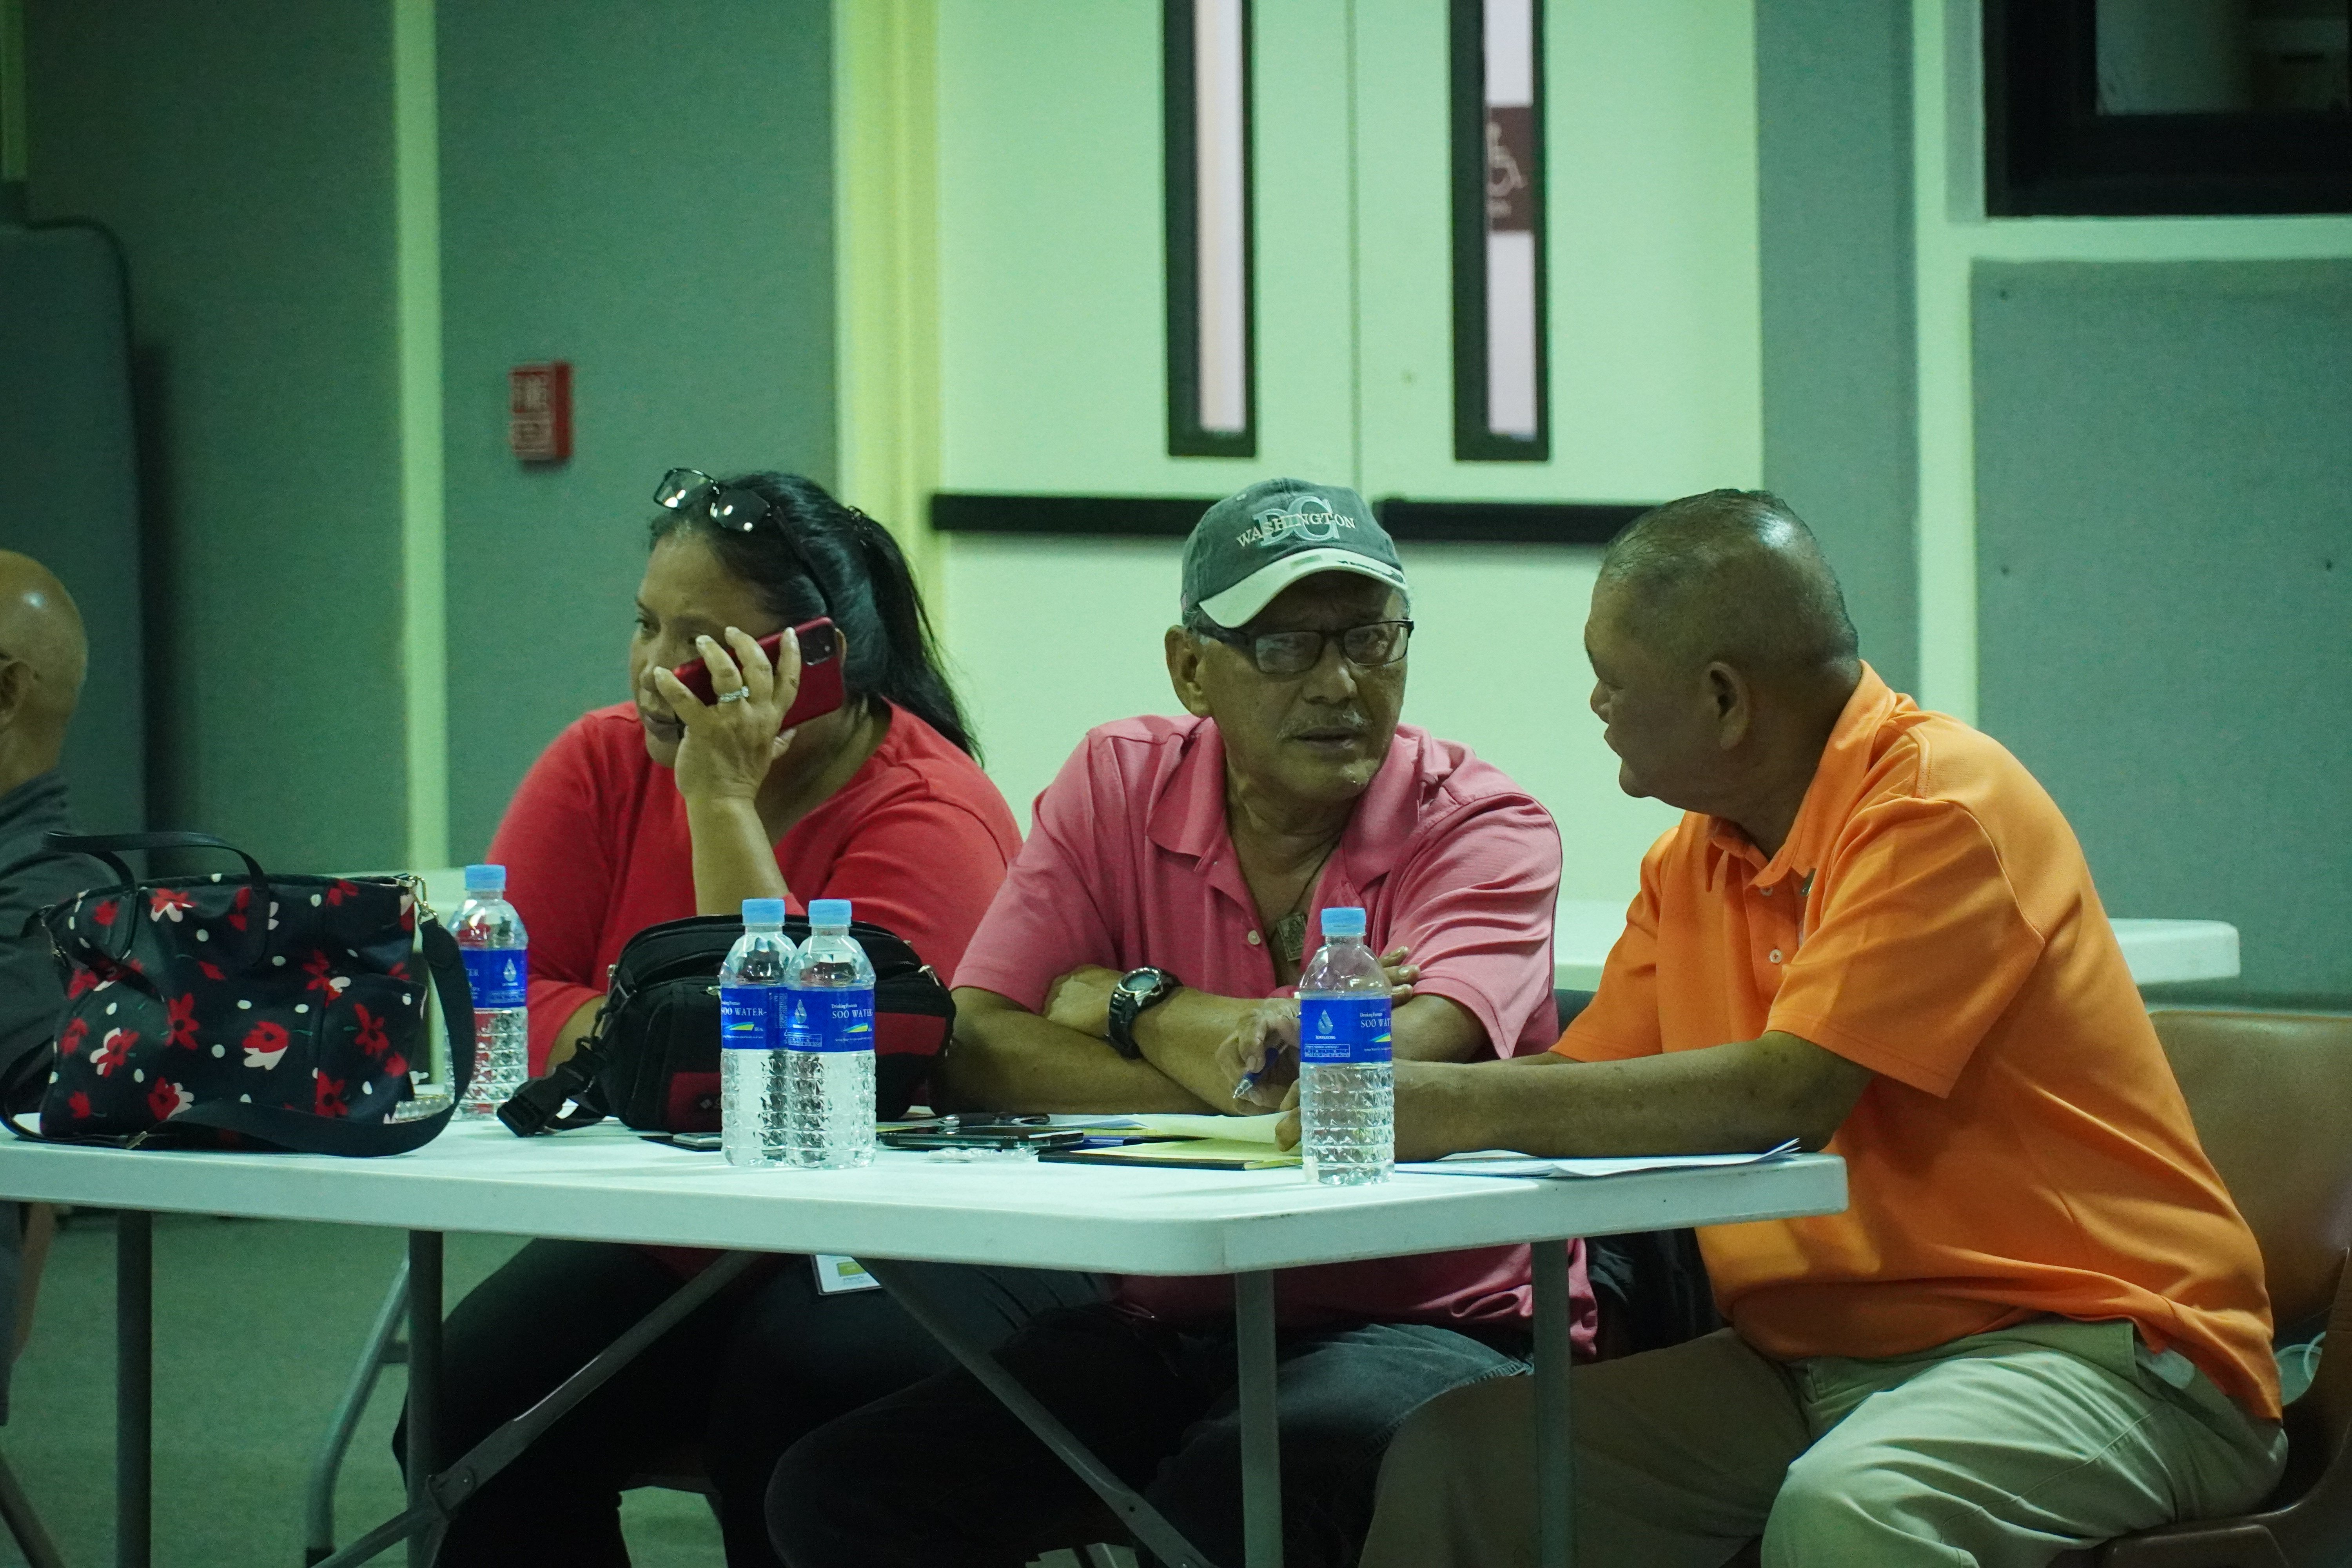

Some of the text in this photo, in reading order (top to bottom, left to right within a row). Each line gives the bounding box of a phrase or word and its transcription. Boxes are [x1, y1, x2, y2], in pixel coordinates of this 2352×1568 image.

[1236, 512, 1356, 547] WASHINGTON
[735, 1007, 764, 1016] WATER
[832, 1010, 849, 1019] SOO
[1361, 1019, 1376, 1028] SOO
